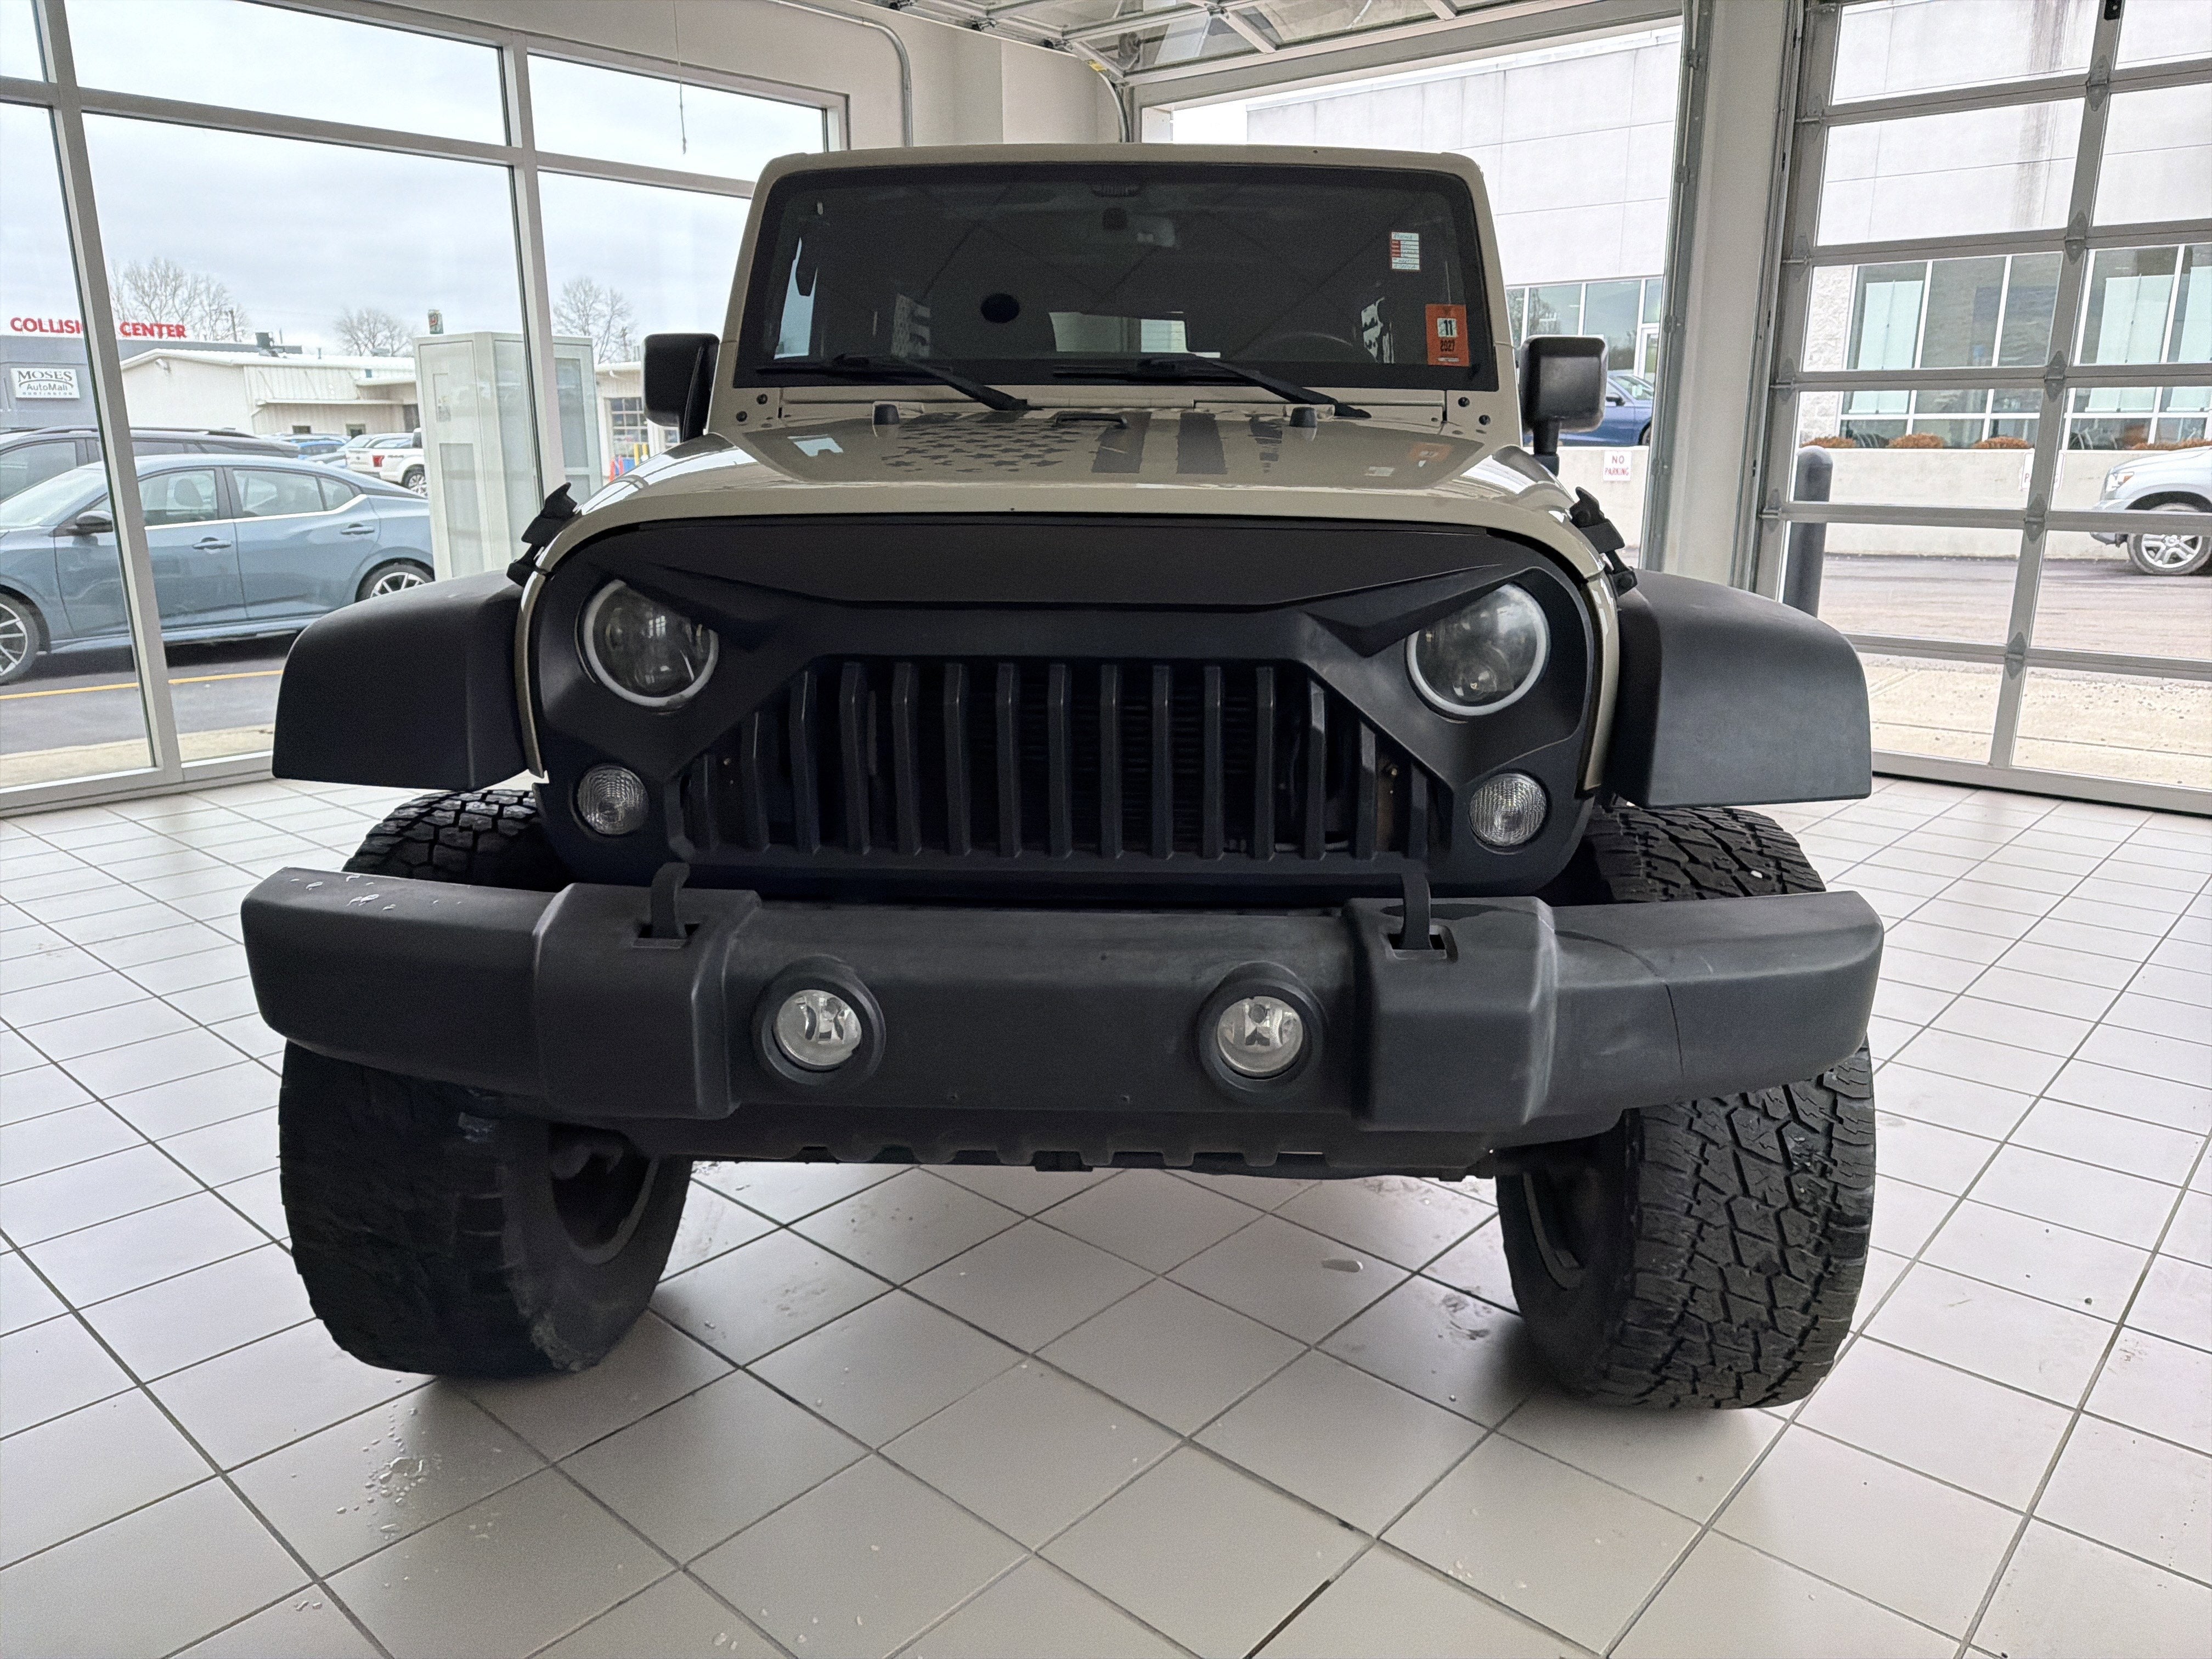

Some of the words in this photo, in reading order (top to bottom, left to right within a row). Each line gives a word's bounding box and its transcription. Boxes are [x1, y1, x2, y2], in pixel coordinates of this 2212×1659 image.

[10, 317, 83, 334] COLLISI
[119, 321, 187, 338] CENTER
[1443, 320, 1453, 336] 11
[17, 370, 72, 383] MOSES
[26, 383, 67, 391] AutoMall
[1612, 455, 1624, 464] NO
[1605, 467, 1629, 476] PARKING
